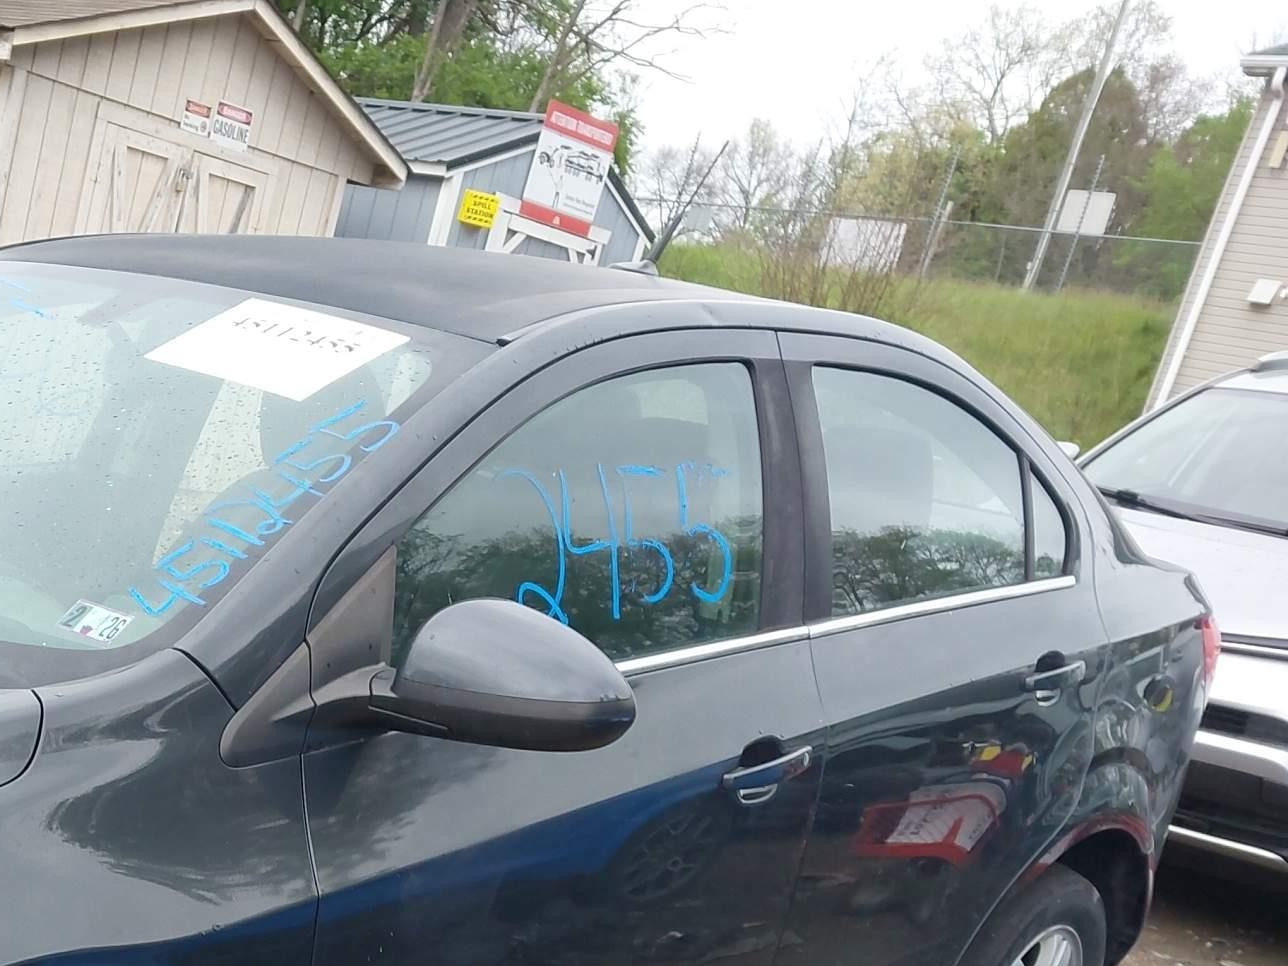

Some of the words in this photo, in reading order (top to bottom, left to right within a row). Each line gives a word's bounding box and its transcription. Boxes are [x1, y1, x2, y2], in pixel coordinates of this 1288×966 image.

[213, 118, 249, 144] GASOLINE
[466, 207, 494, 219] STATION
[473, 200, 492, 210] SPILL
[127, 399, 402, 618] 45112455
[497, 461, 732, 626] 2455
[97, 615, 128, 640] 26
